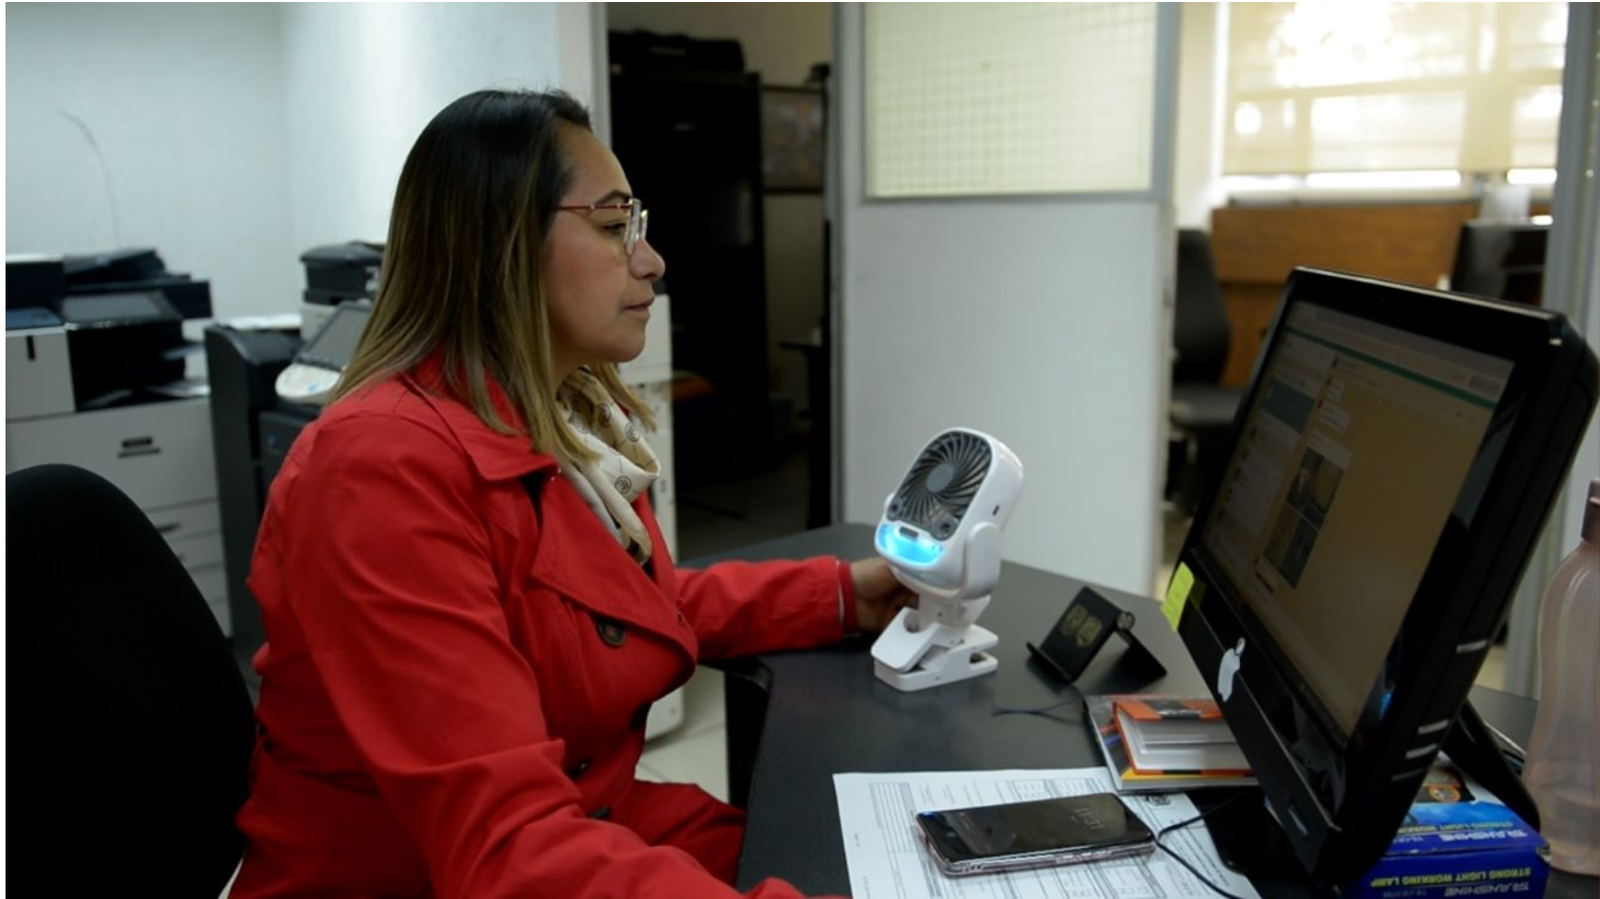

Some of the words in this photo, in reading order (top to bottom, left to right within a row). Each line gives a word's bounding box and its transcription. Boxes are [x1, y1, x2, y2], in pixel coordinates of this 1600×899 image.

[1455, 871, 1486, 882] LIGHT
[1489, 867, 1531, 880] STRONG
[1370, 876, 1399, 888] LAMP
[1402, 874, 1453, 886] WORKING
